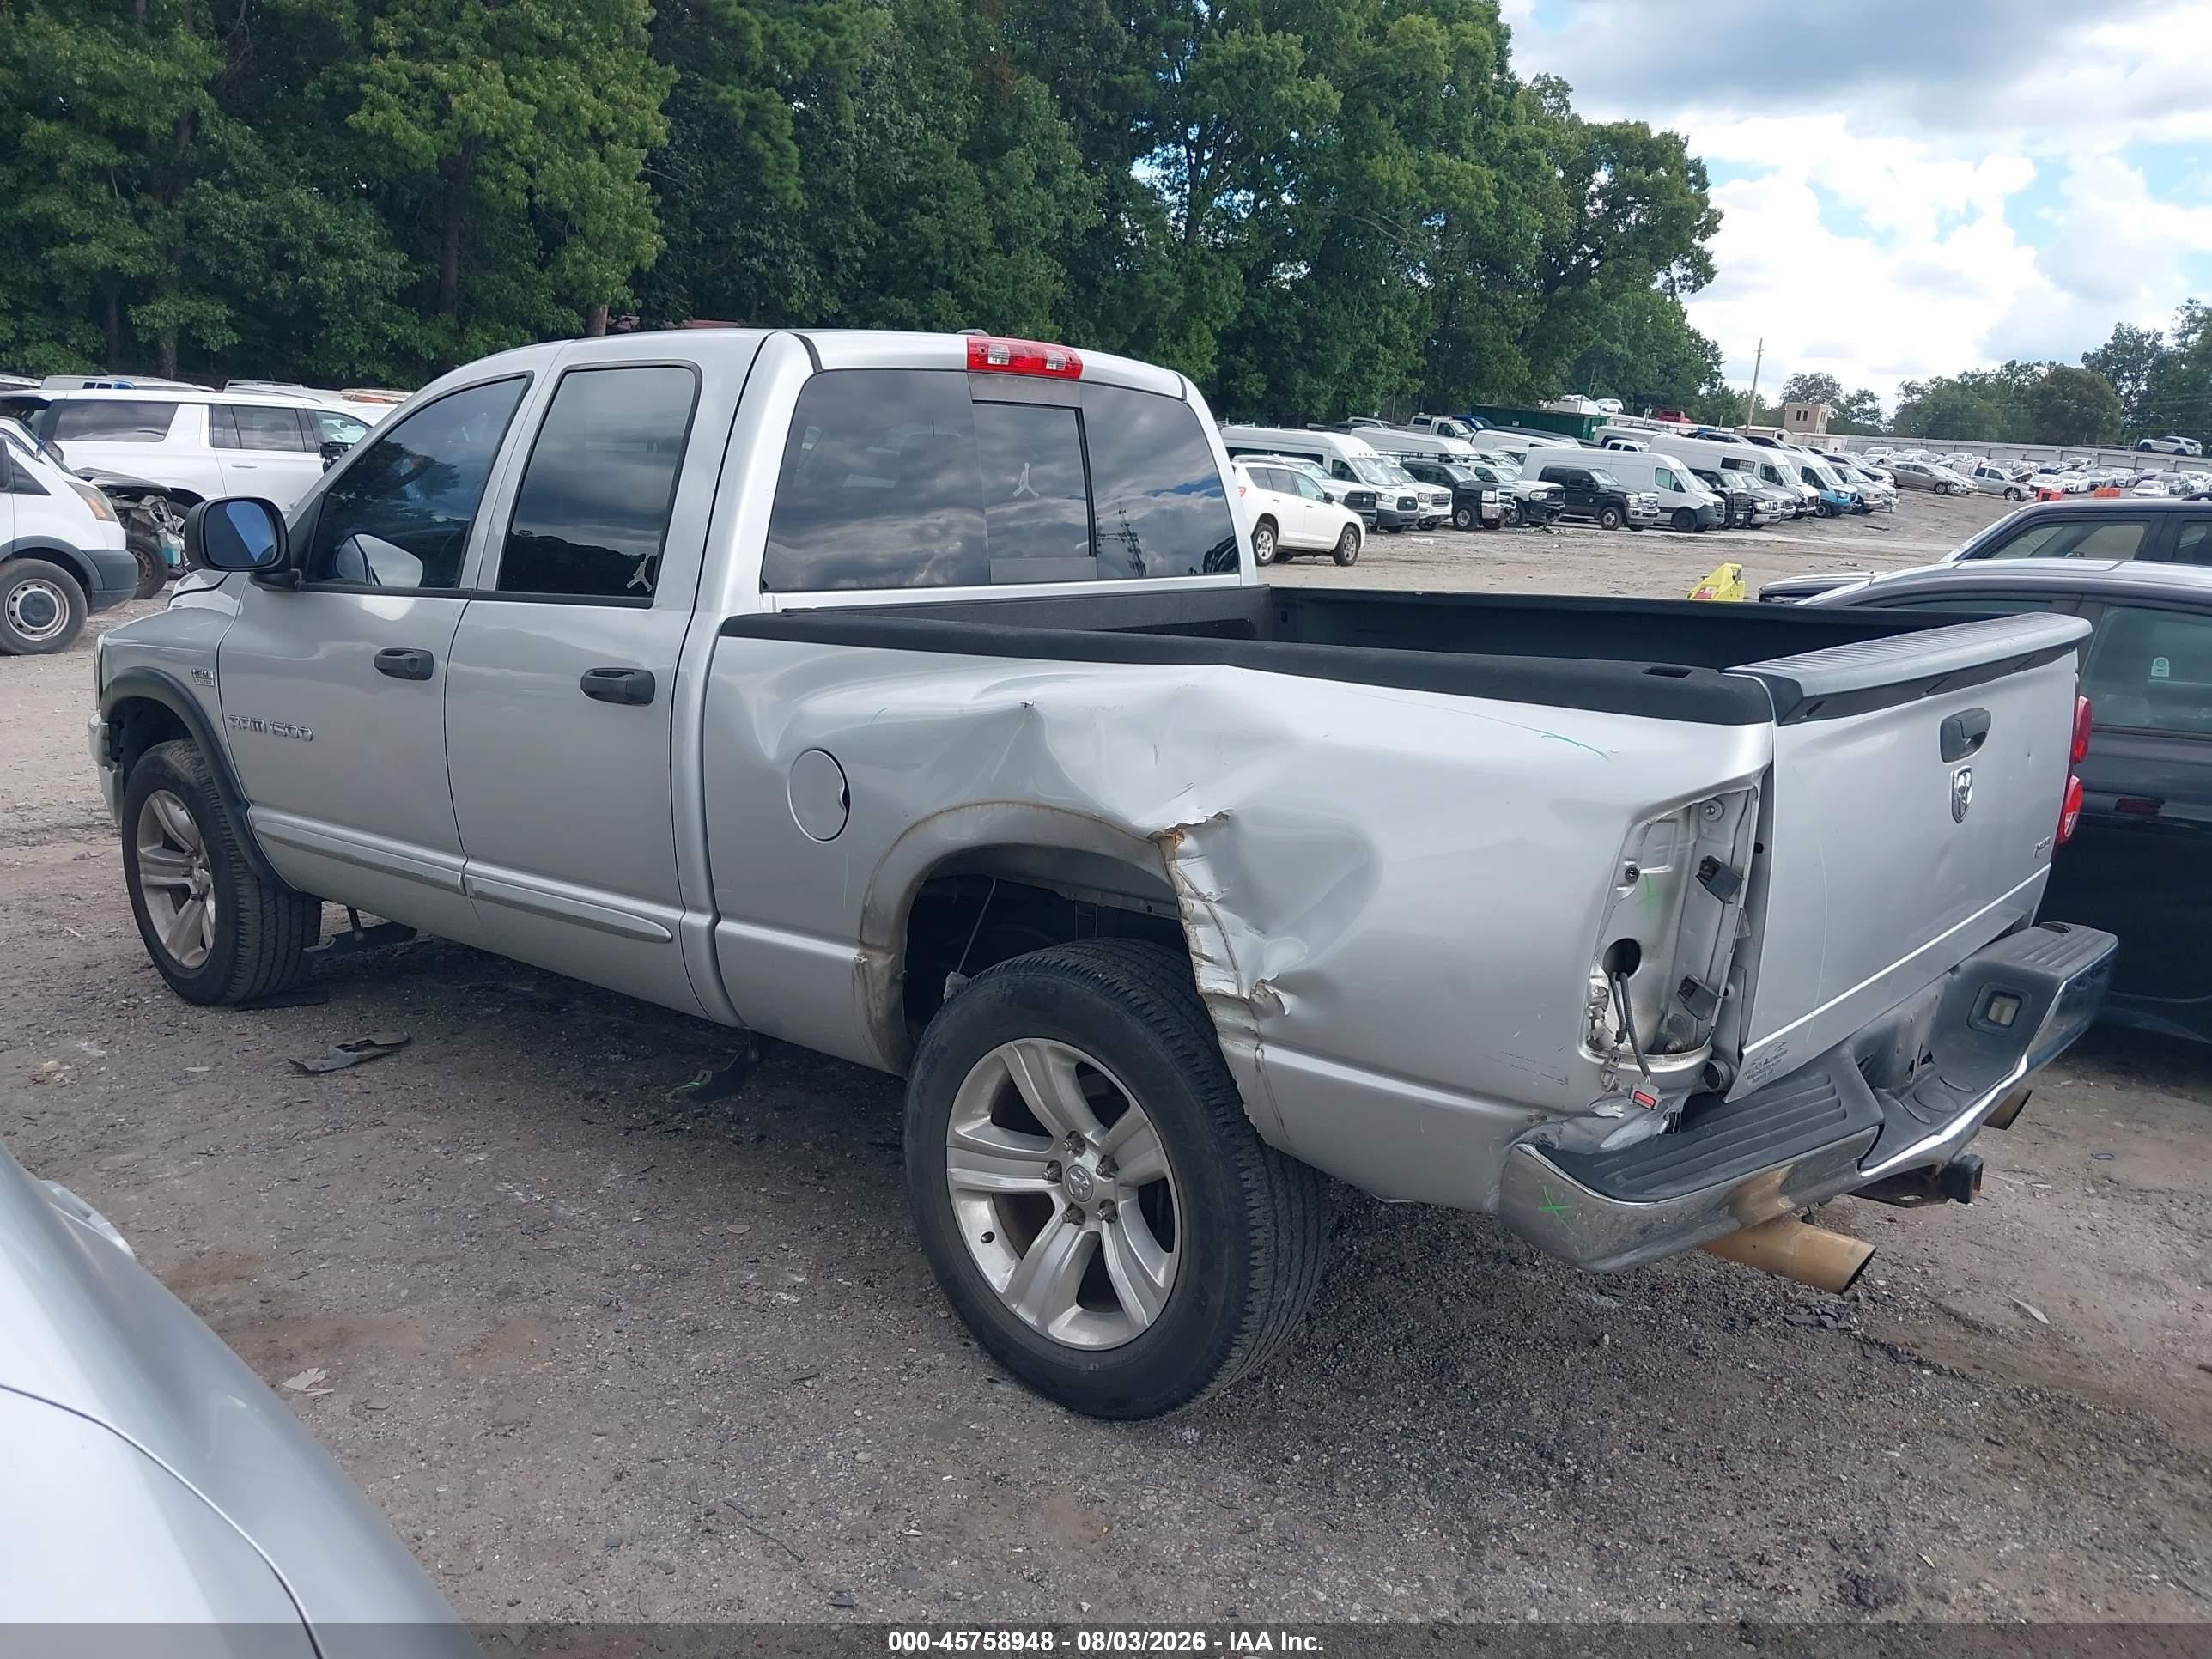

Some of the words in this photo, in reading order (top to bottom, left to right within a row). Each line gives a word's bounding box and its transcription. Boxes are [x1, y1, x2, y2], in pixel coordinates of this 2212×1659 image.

[191, 668, 214, 680] HEMI
[228, 714, 268, 734] RAM
[270, 720, 314, 742] 1500
